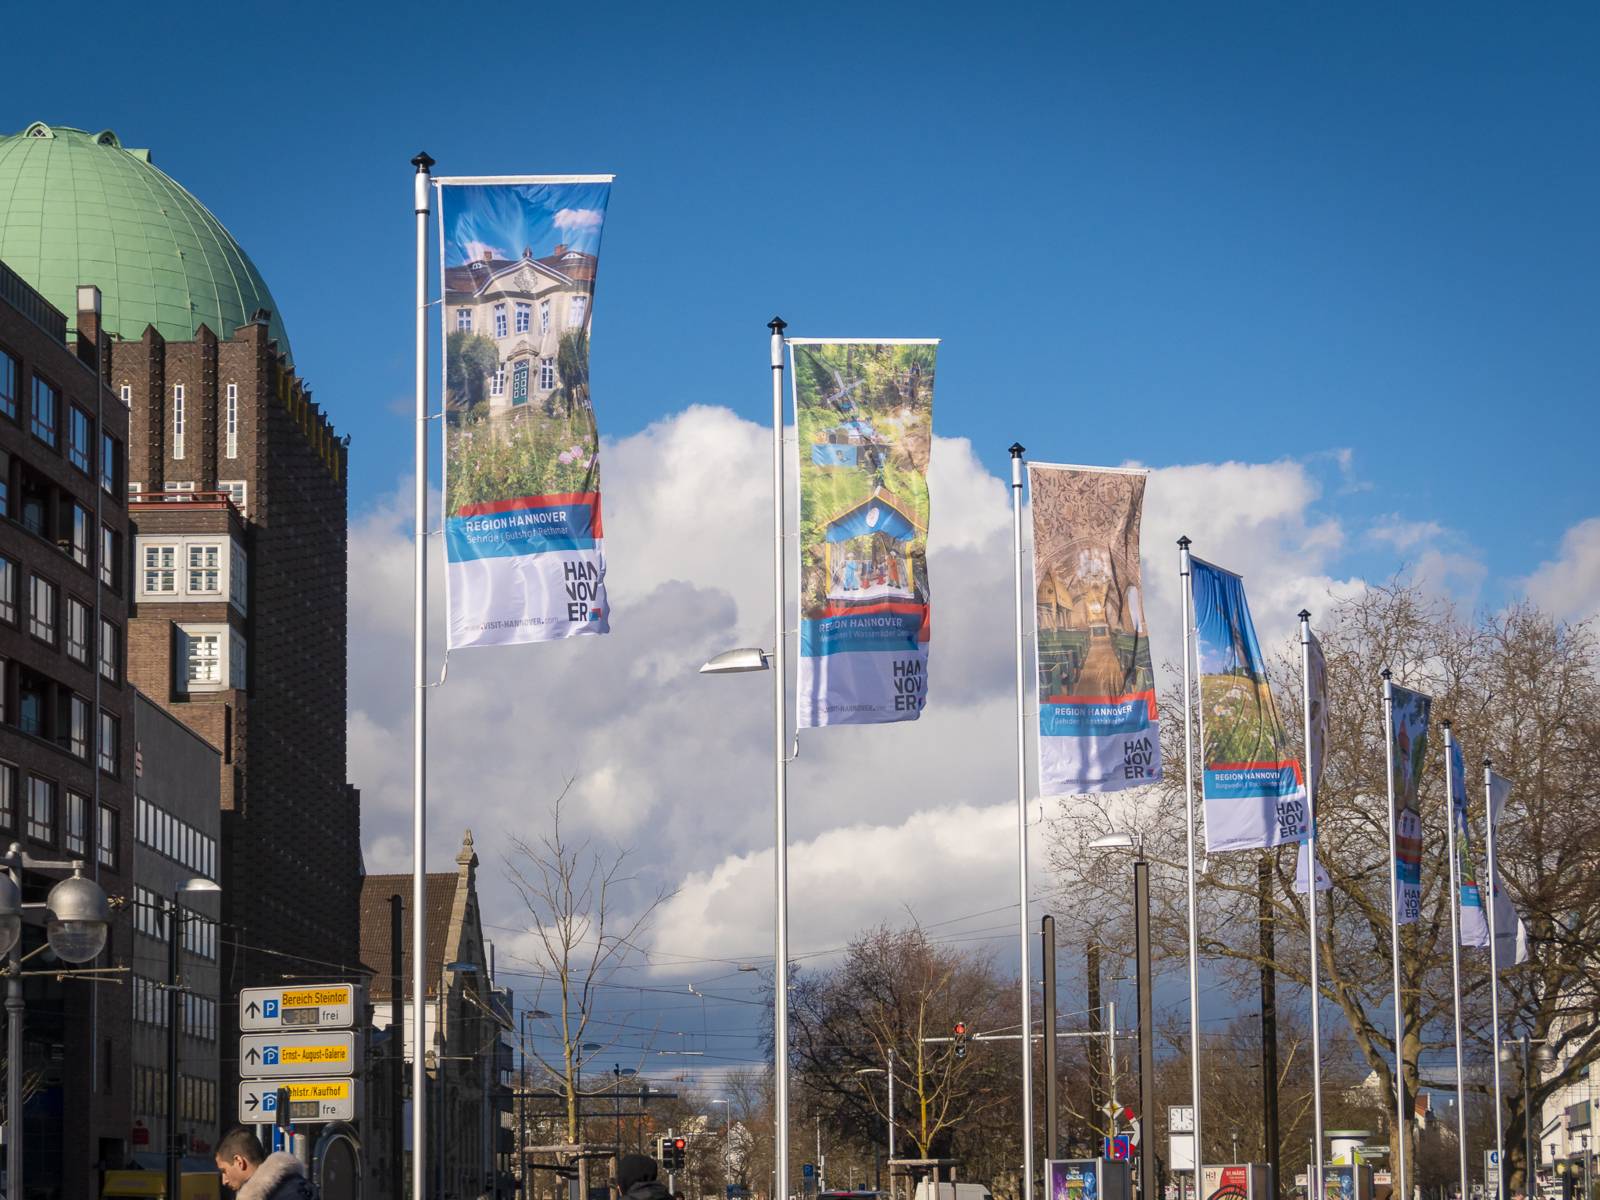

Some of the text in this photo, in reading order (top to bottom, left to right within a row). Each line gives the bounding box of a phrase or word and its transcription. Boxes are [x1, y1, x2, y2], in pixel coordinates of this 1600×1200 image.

[466, 511, 567, 532] REGION HANNOVER
[467, 534, 499, 544] Sehnde
[564, 561, 598, 581] HAN
[568, 602, 588, 621] ER
[850, 617, 903, 628] HANNOVER
[895, 695, 917, 711] ER
[1088, 704, 1132, 716] HANNOVER
[1125, 766, 1144, 779] ER
[1215, 773, 1243, 781] REGION
[1280, 825, 1298, 838] ER
[282, 991, 347, 1005] Bereich Steintor
[322, 1010, 339, 1021] frei
[282, 1048, 346, 1062] Ernst- August-Galerie
